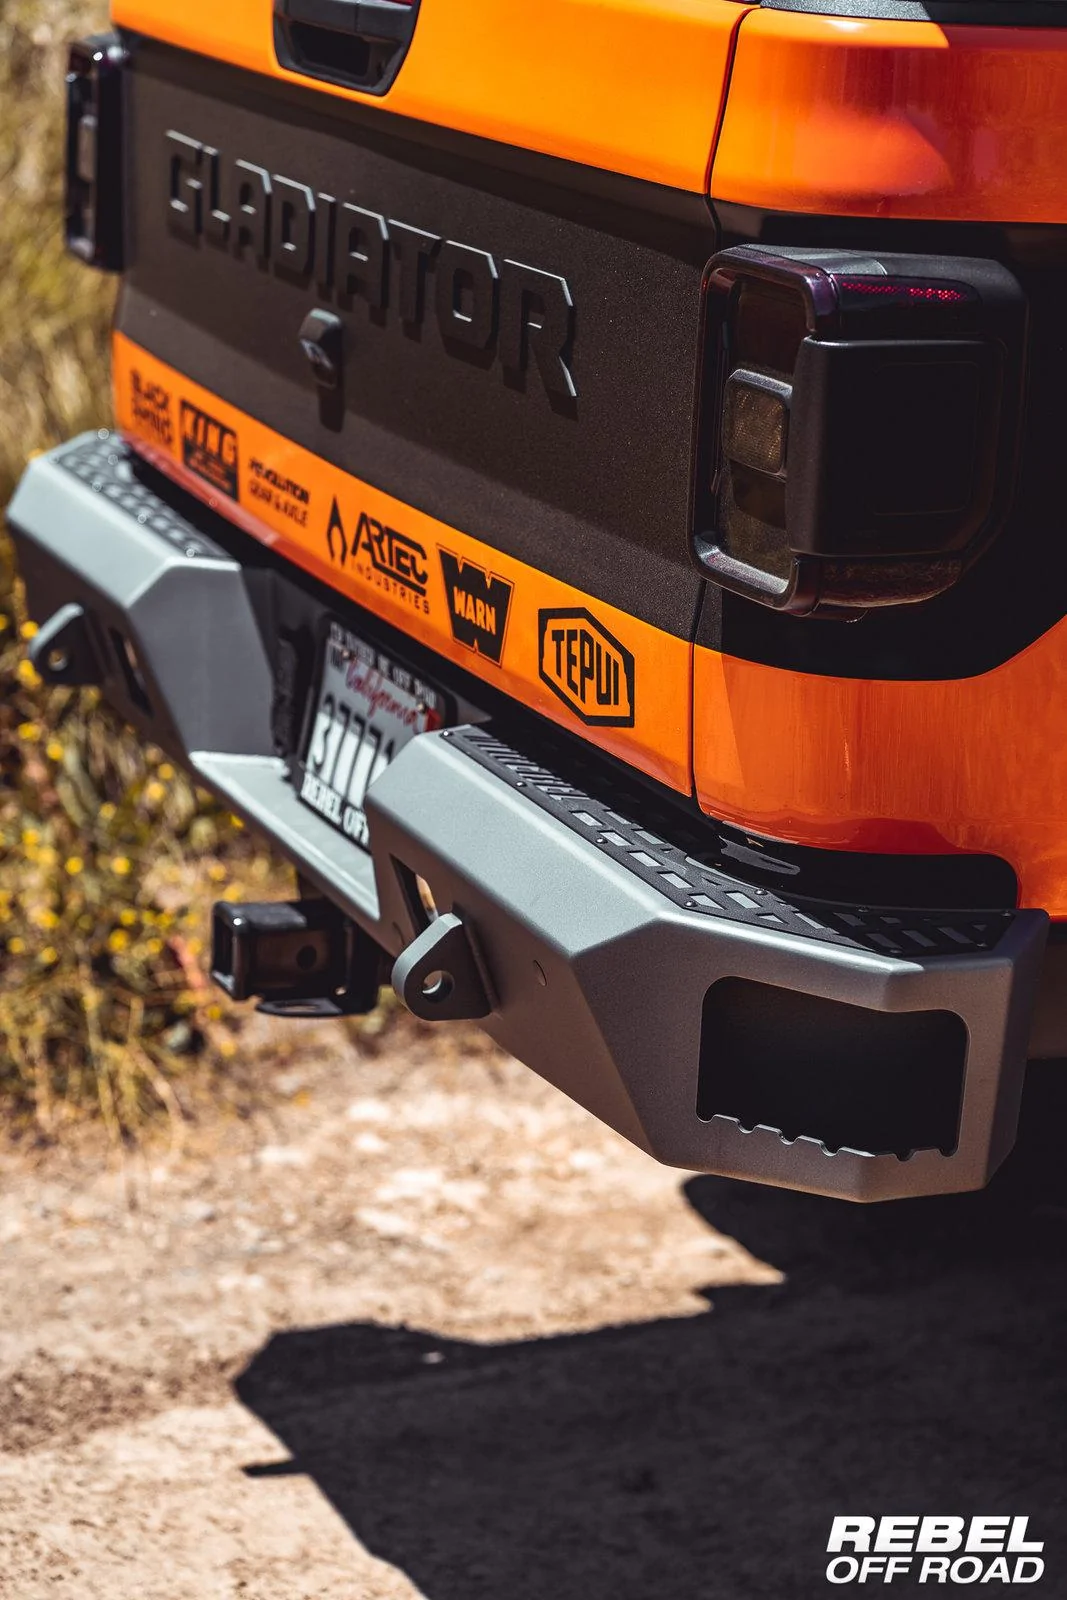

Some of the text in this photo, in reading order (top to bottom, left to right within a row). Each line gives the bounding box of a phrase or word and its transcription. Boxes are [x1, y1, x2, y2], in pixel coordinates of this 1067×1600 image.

[165, 129, 579, 400] GLADIATOR
[248, 457, 310, 504] REVOLUTION
[351, 511, 428, 597] ARTEC
[351, 560, 430, 615] INDUSTRIES
[453, 586, 496, 635] WARN
[551, 628, 620, 706] TEPUI
